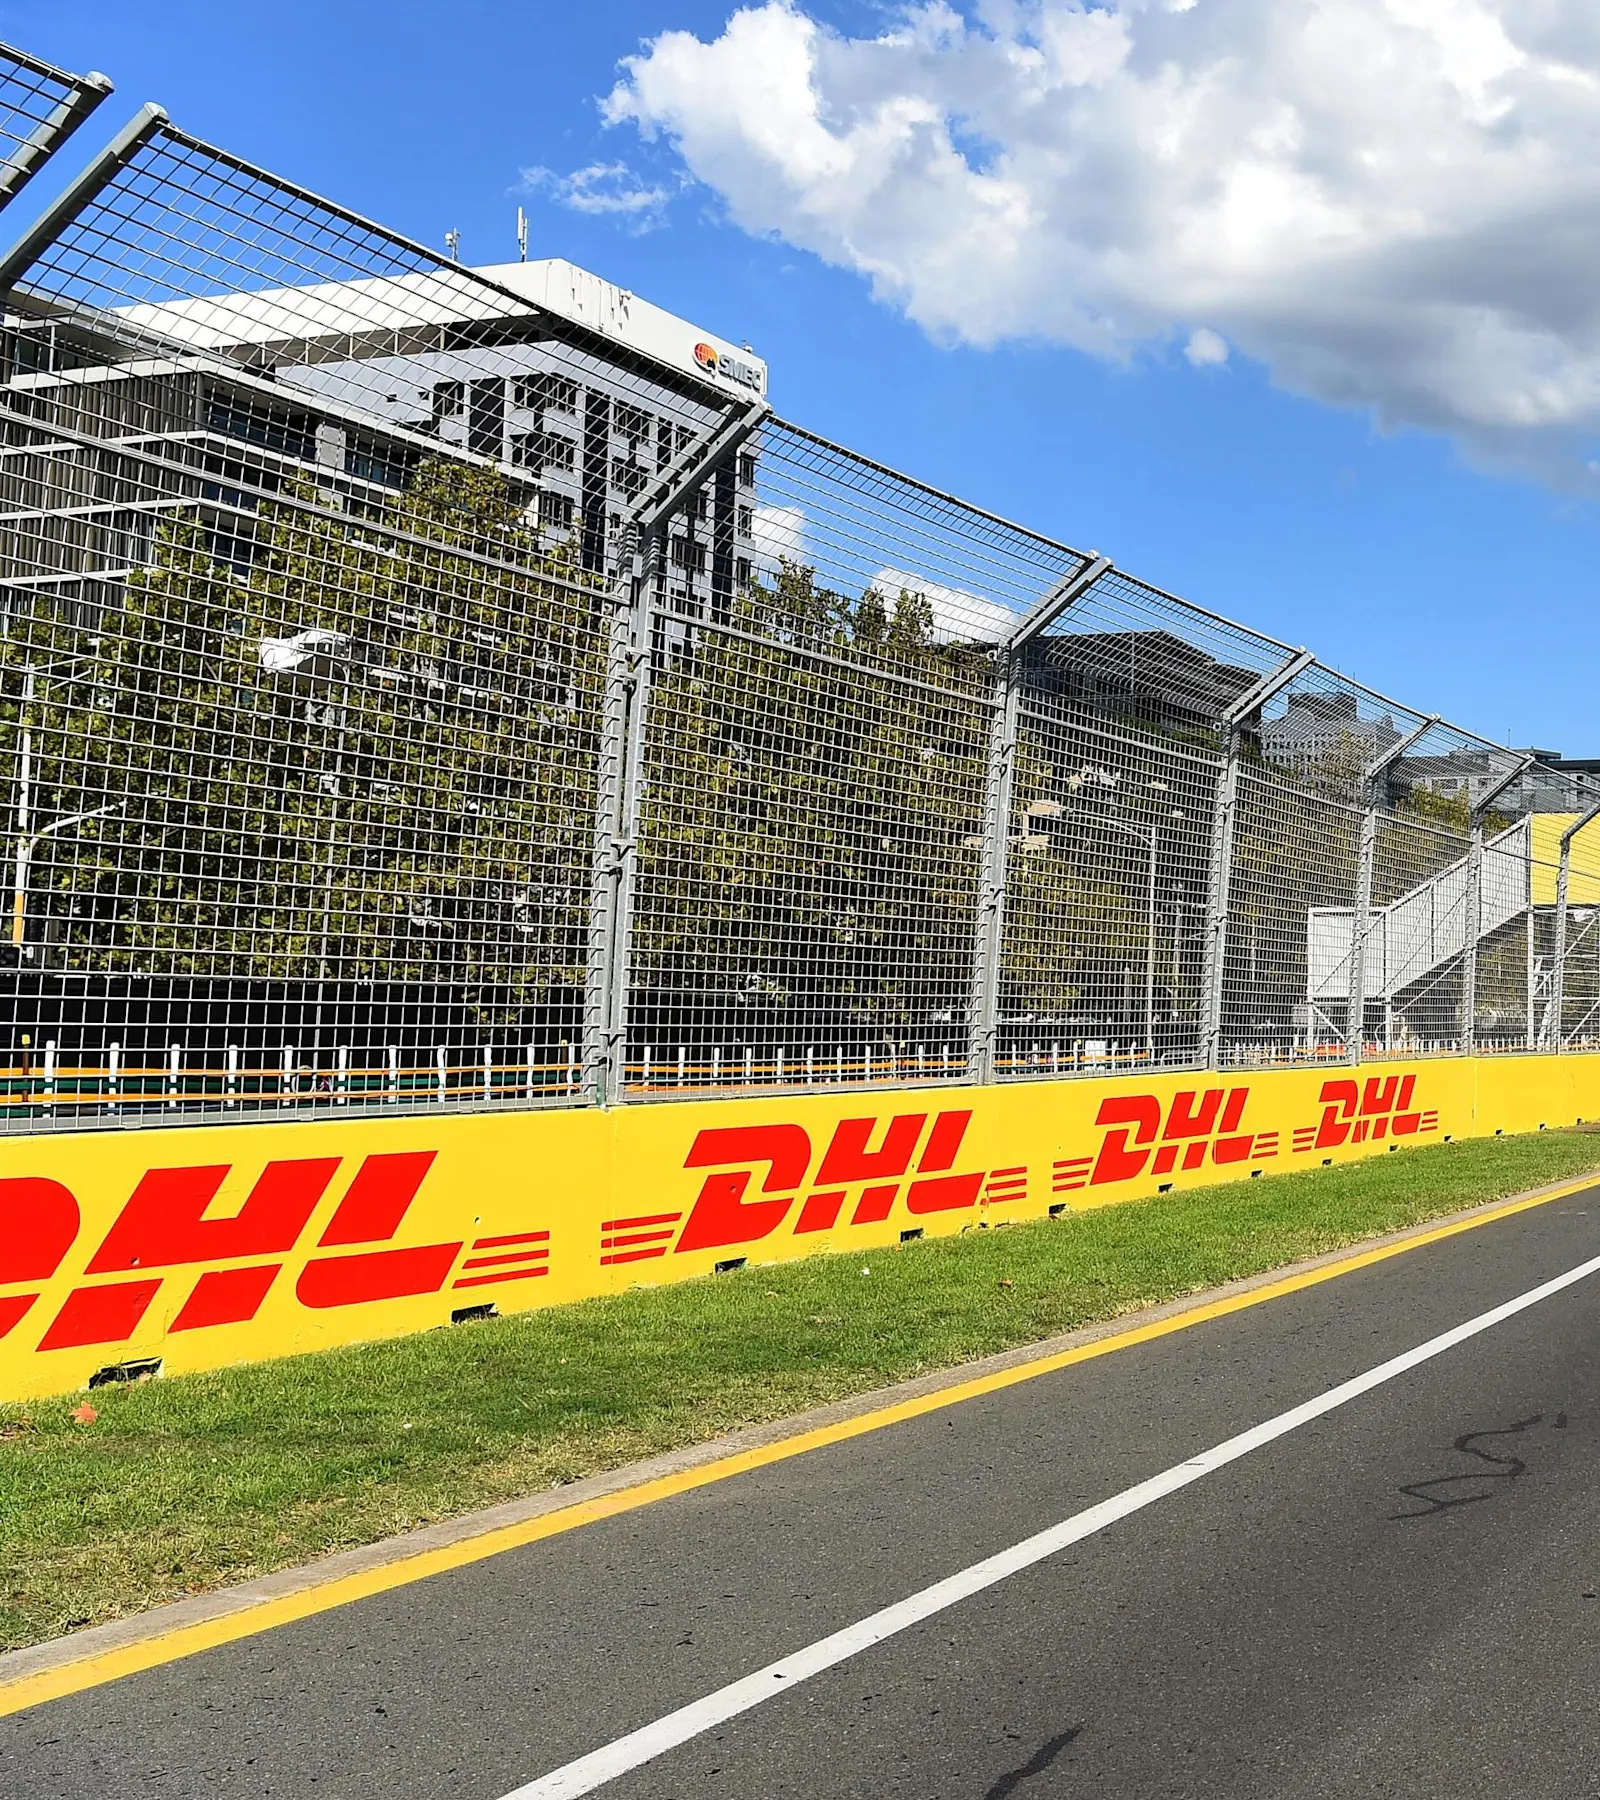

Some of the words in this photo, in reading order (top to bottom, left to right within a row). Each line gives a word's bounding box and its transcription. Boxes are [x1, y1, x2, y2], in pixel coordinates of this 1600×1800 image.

[718, 355, 761, 389] SMEC
[1090, 1087, 1255, 1186] DHL
[1315, 1074, 1422, 1148] DHL
[674, 1109, 986, 1254] DHL
[0, 1150, 464, 1353] HL
